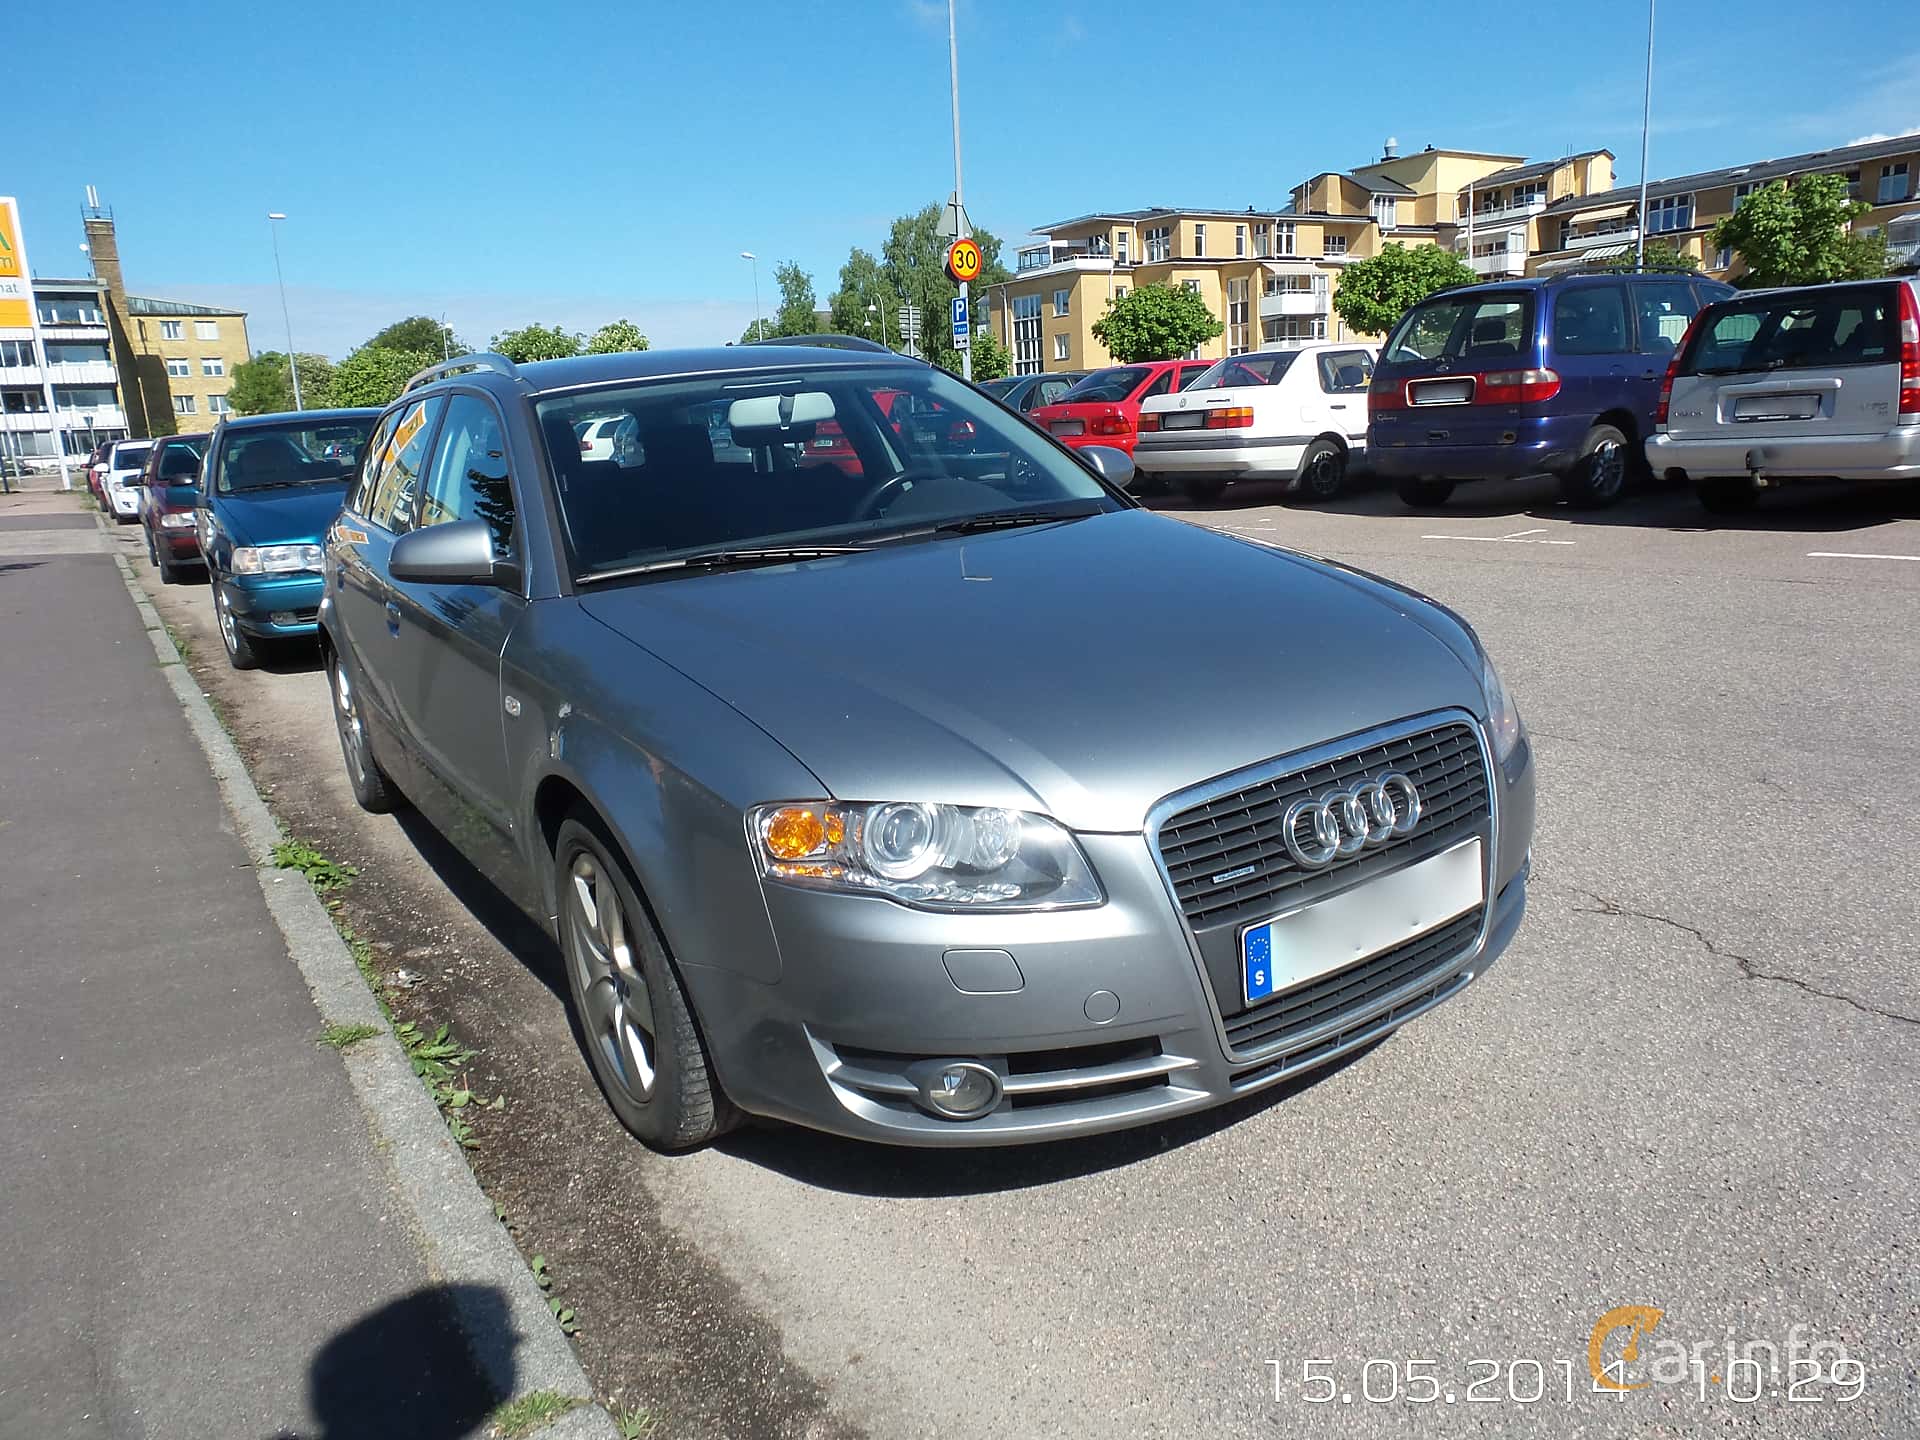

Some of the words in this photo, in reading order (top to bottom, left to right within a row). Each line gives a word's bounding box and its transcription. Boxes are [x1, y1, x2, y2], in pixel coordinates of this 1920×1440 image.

[955, 250, 976, 270] 30
[955, 300, 965, 321] P
[1255, 970, 1265, 986] S
